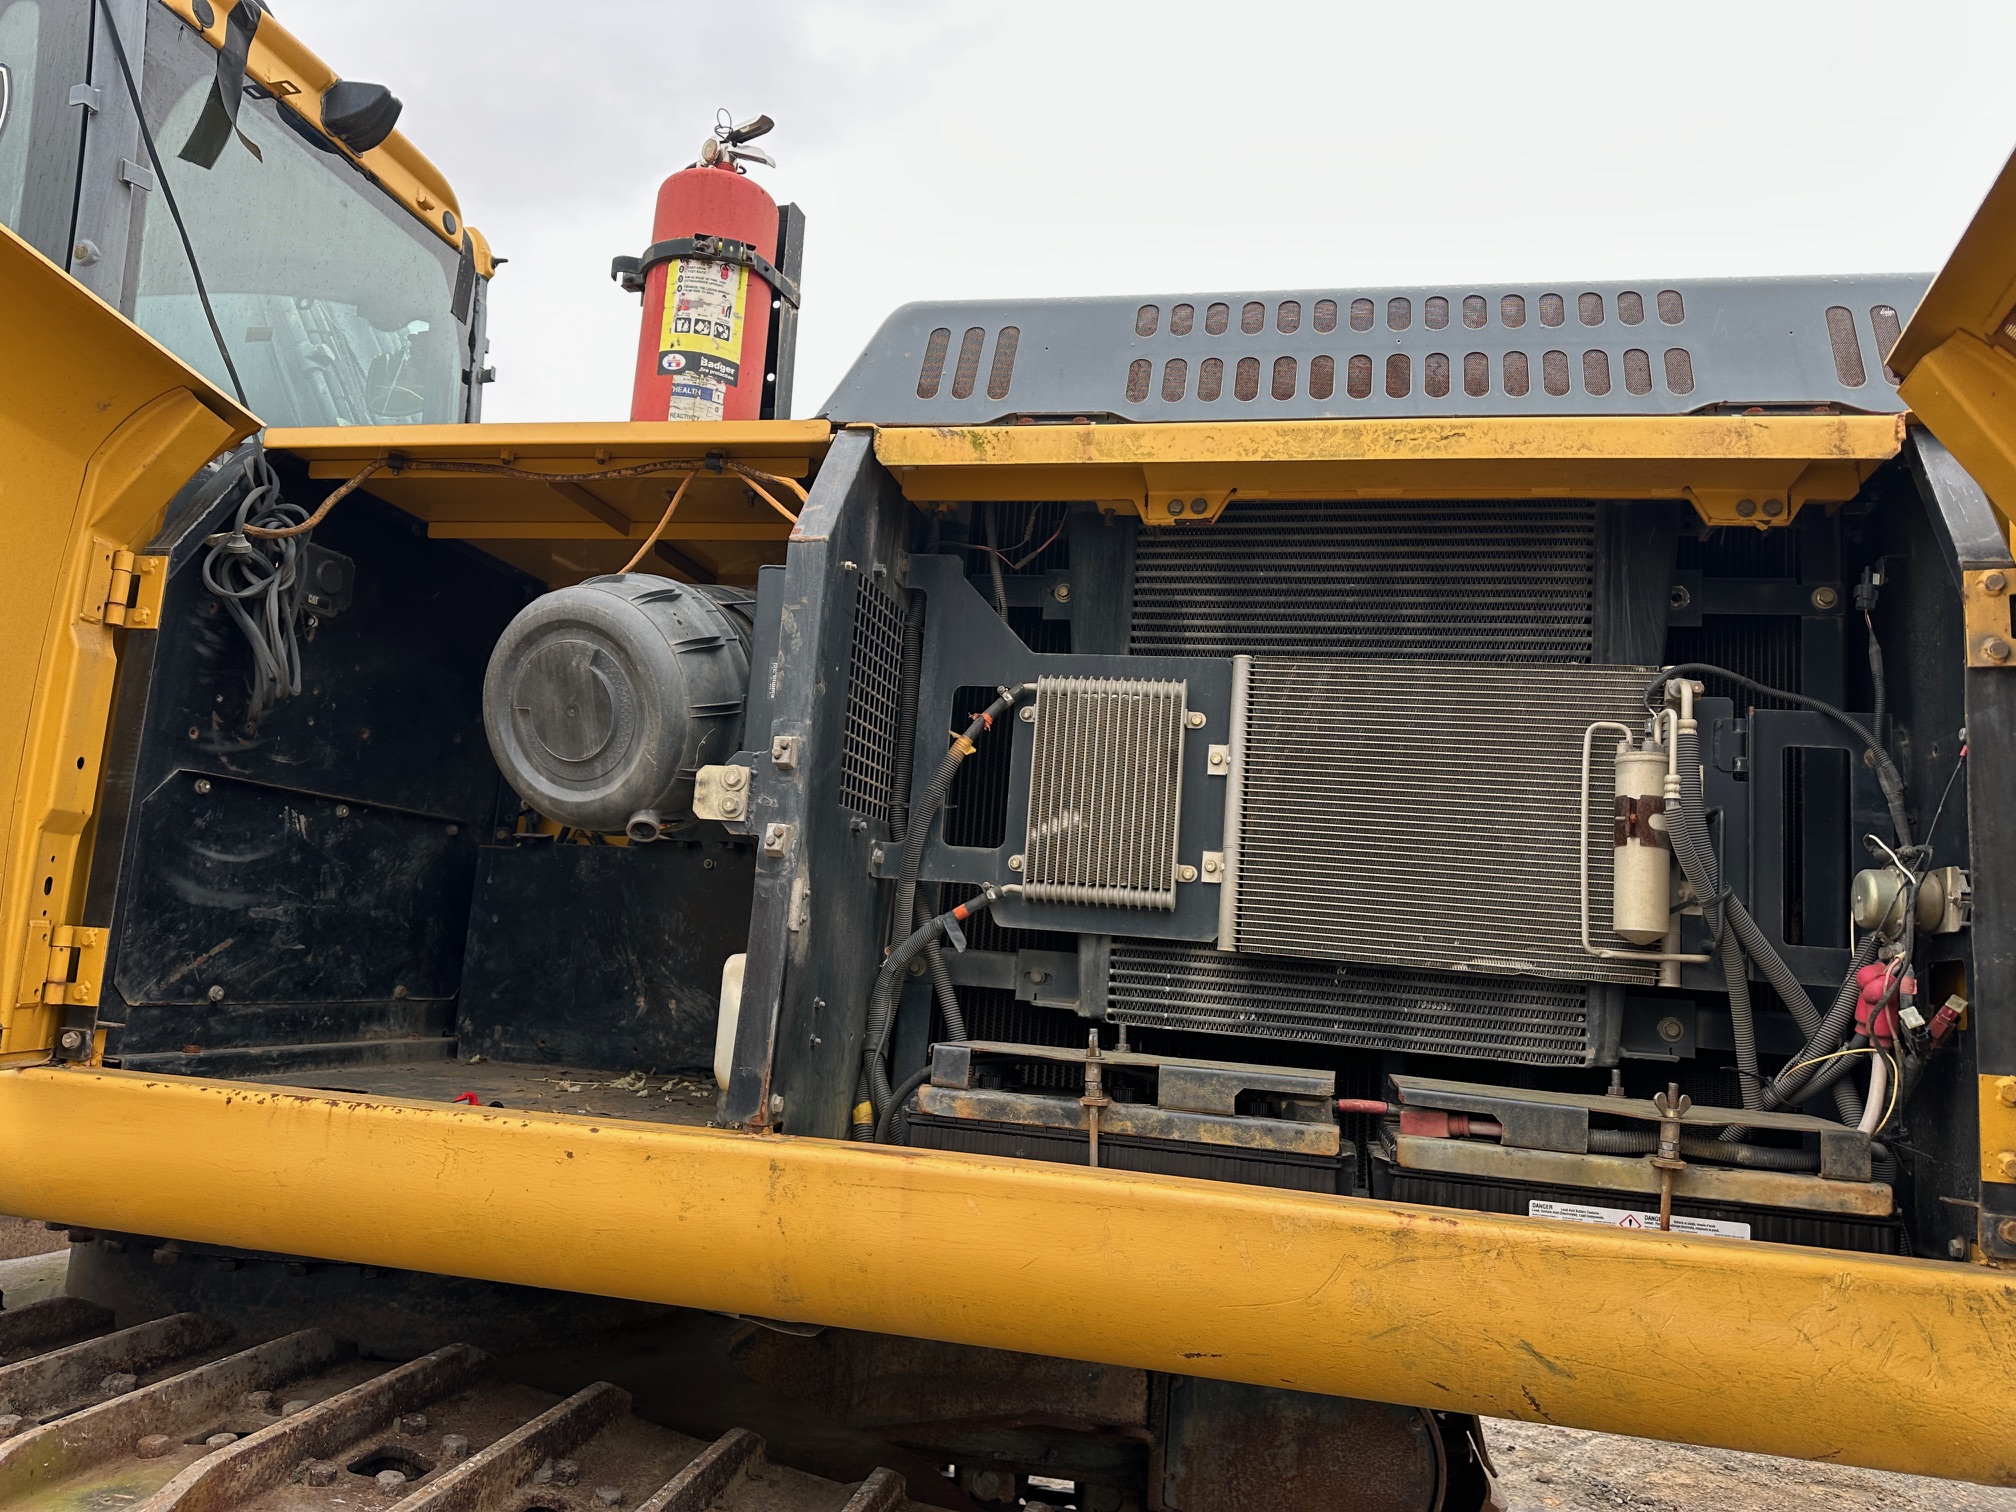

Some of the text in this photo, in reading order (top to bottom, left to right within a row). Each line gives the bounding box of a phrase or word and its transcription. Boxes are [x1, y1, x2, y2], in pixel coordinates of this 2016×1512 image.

[700, 358, 735, 374] Badger
[710, 369, 734, 380] protection
[672, 386, 701, 395] HEALTH
